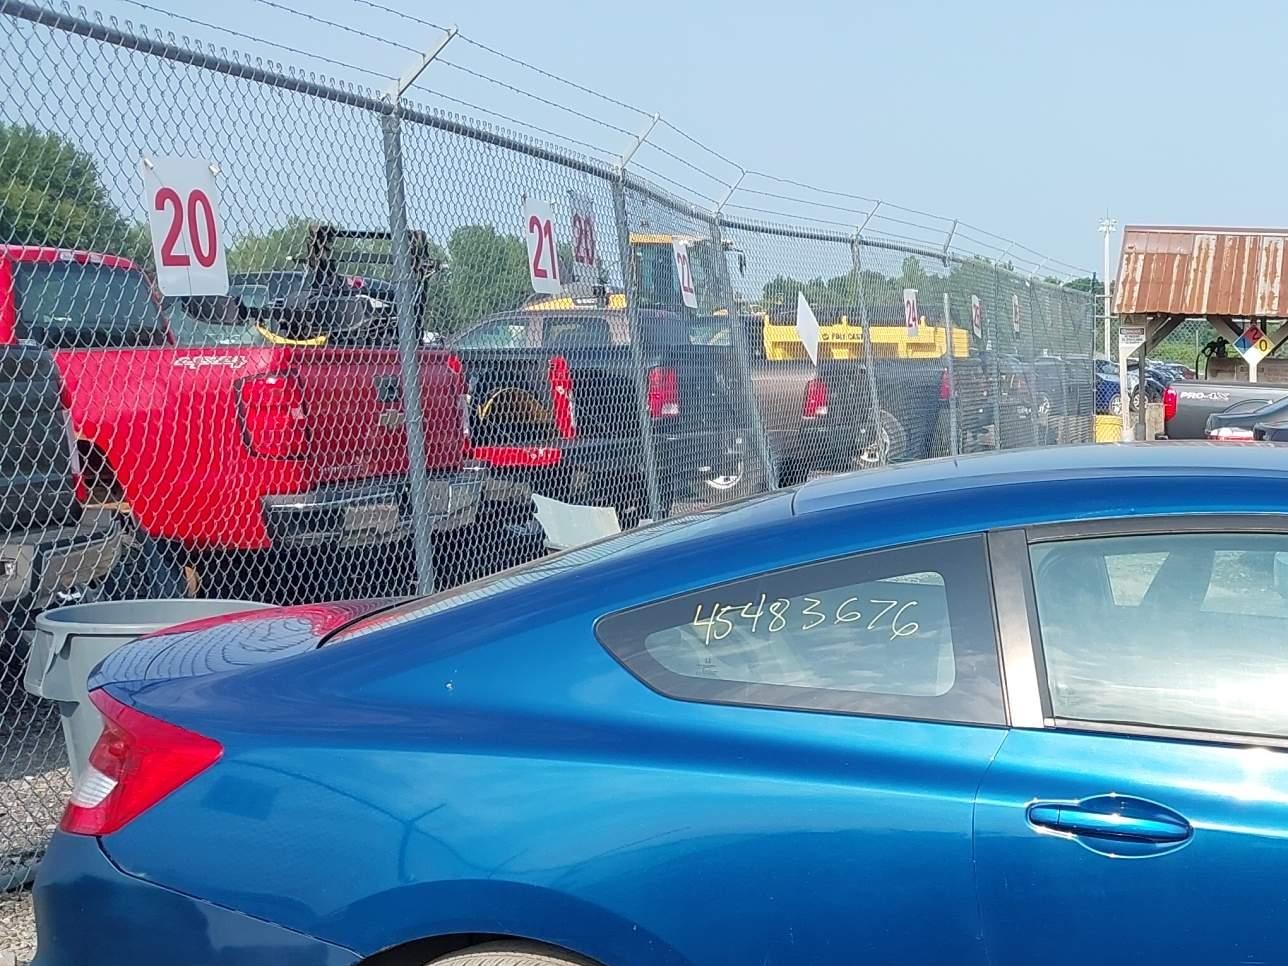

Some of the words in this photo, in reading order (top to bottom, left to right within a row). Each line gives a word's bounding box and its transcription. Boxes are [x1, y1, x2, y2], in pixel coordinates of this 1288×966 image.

[154, 186, 218, 269] 20
[528, 215, 557, 280] 21
[1259, 339, 1268, 352] 0
[692, 593, 919, 647] 45483676
